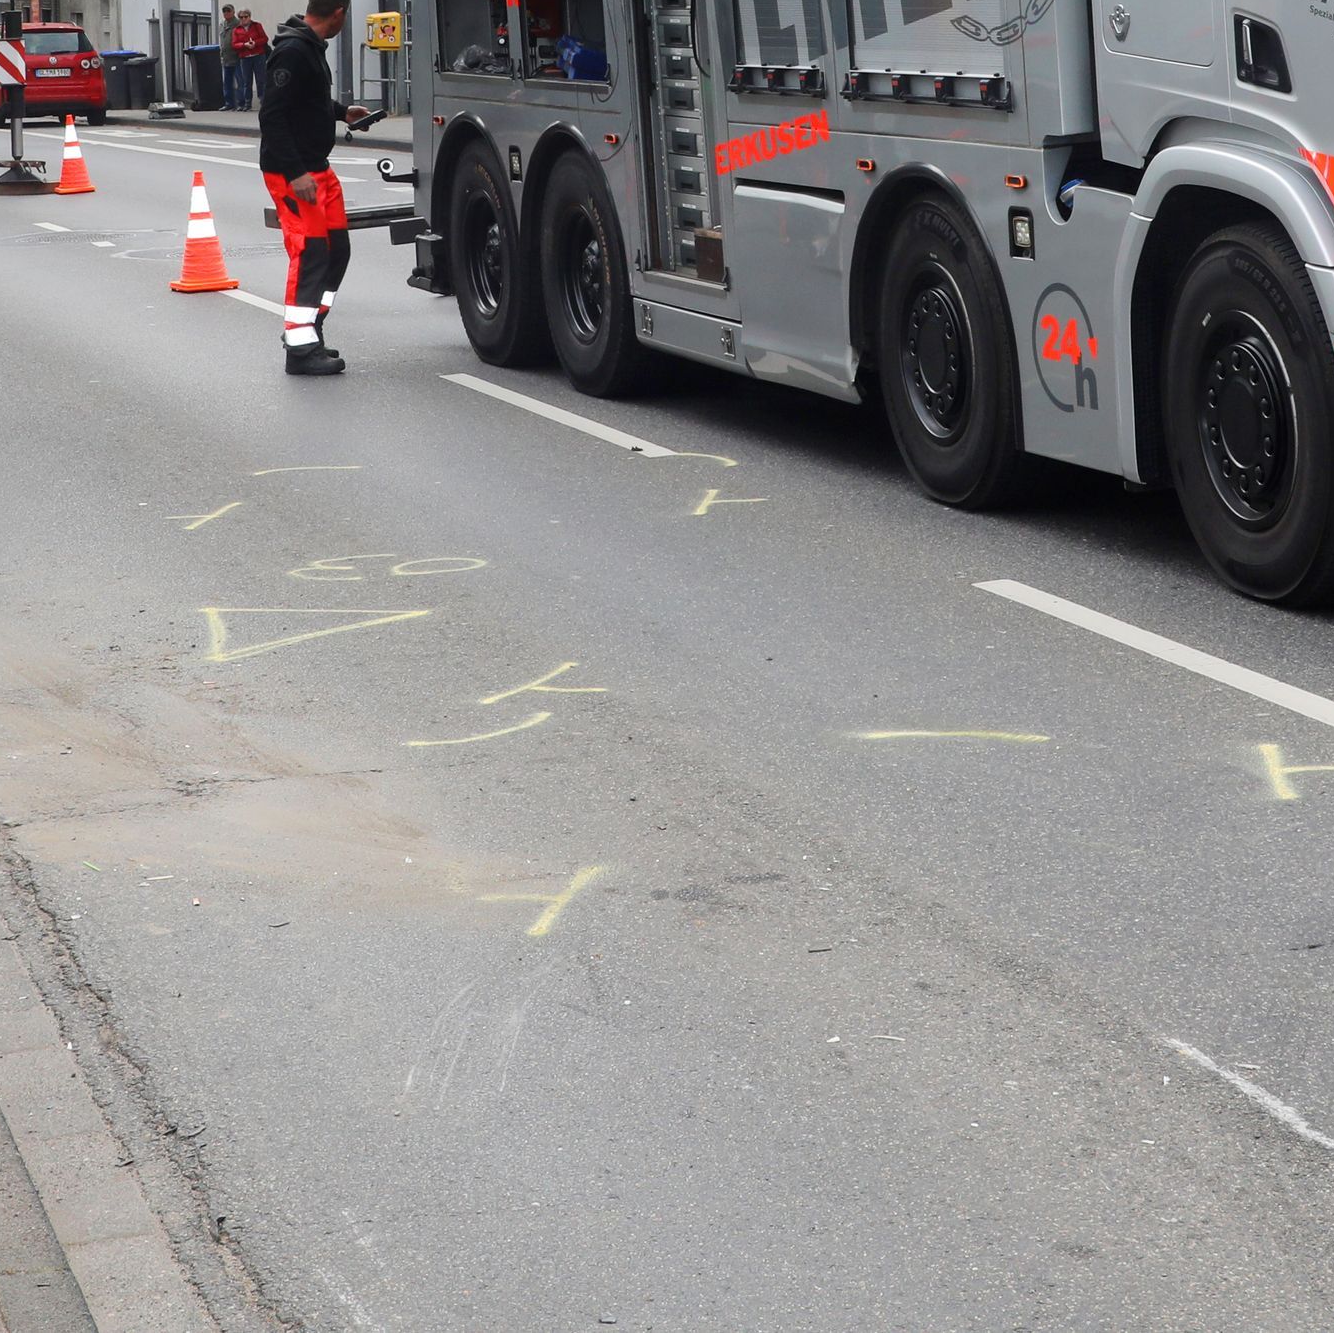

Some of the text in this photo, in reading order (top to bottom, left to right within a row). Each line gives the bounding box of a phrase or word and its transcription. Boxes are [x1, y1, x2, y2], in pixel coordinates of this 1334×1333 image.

[715, 109, 830, 176] ERKUSEN
[1041, 314, 1098, 410] 24 h
